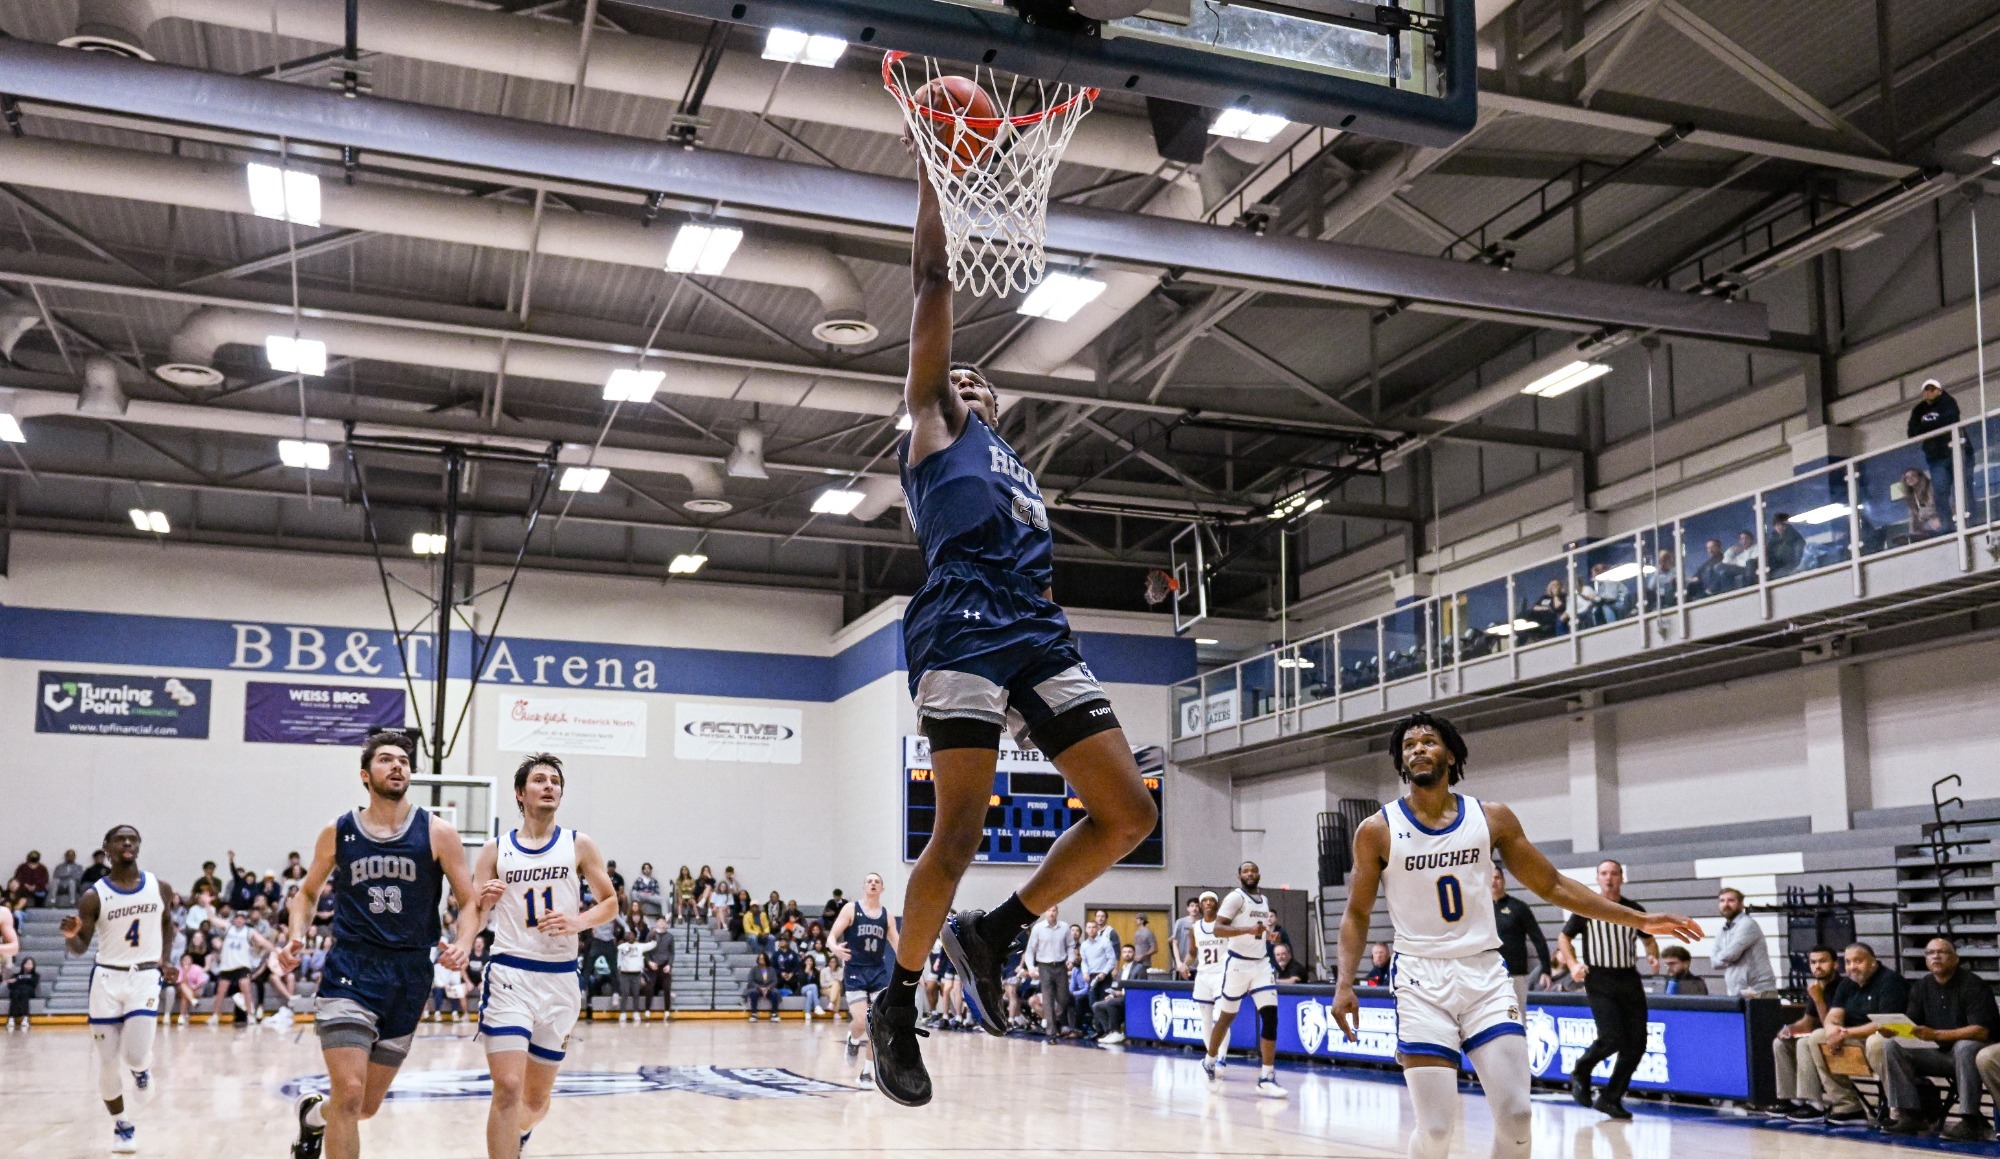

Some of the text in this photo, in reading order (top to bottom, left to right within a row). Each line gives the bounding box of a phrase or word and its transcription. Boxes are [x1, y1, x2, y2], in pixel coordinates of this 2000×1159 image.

[989, 446, 1043, 499] HOO
[1011, 487, 1050, 531] 20
[229, 624, 658, 690] BB&T Arena
[78, 682, 153, 706] Turning
[289, 689, 370, 704] WEISS BROS.
[80, 699, 130, 715] Point
[69, 723, 178, 736] www.tpfinancial.com
[573, 716, 611, 727] Frederick
[613, 719, 635, 727] North
[700, 721, 778, 736] ACTIVE
[1011, 750, 1039, 761] THE
[1027, 801, 1048, 810] PERIOD
[1019, 829, 1041, 837] PLAYER
[1405, 848, 1480, 871] GOUCHER
[350, 855, 416, 886] HOOD
[505, 866, 569, 884] GOUCHER
[368, 885, 402, 914] 33
[523, 885, 554, 928] 11
[1437, 874, 1464, 923] 0
[107, 903, 158, 921] GOUCHER
[124, 918, 140, 948] 4
[857, 924, 884, 939] HOOD
[864, 938, 878, 952] 14
[1204, 948, 1219, 965] 21
